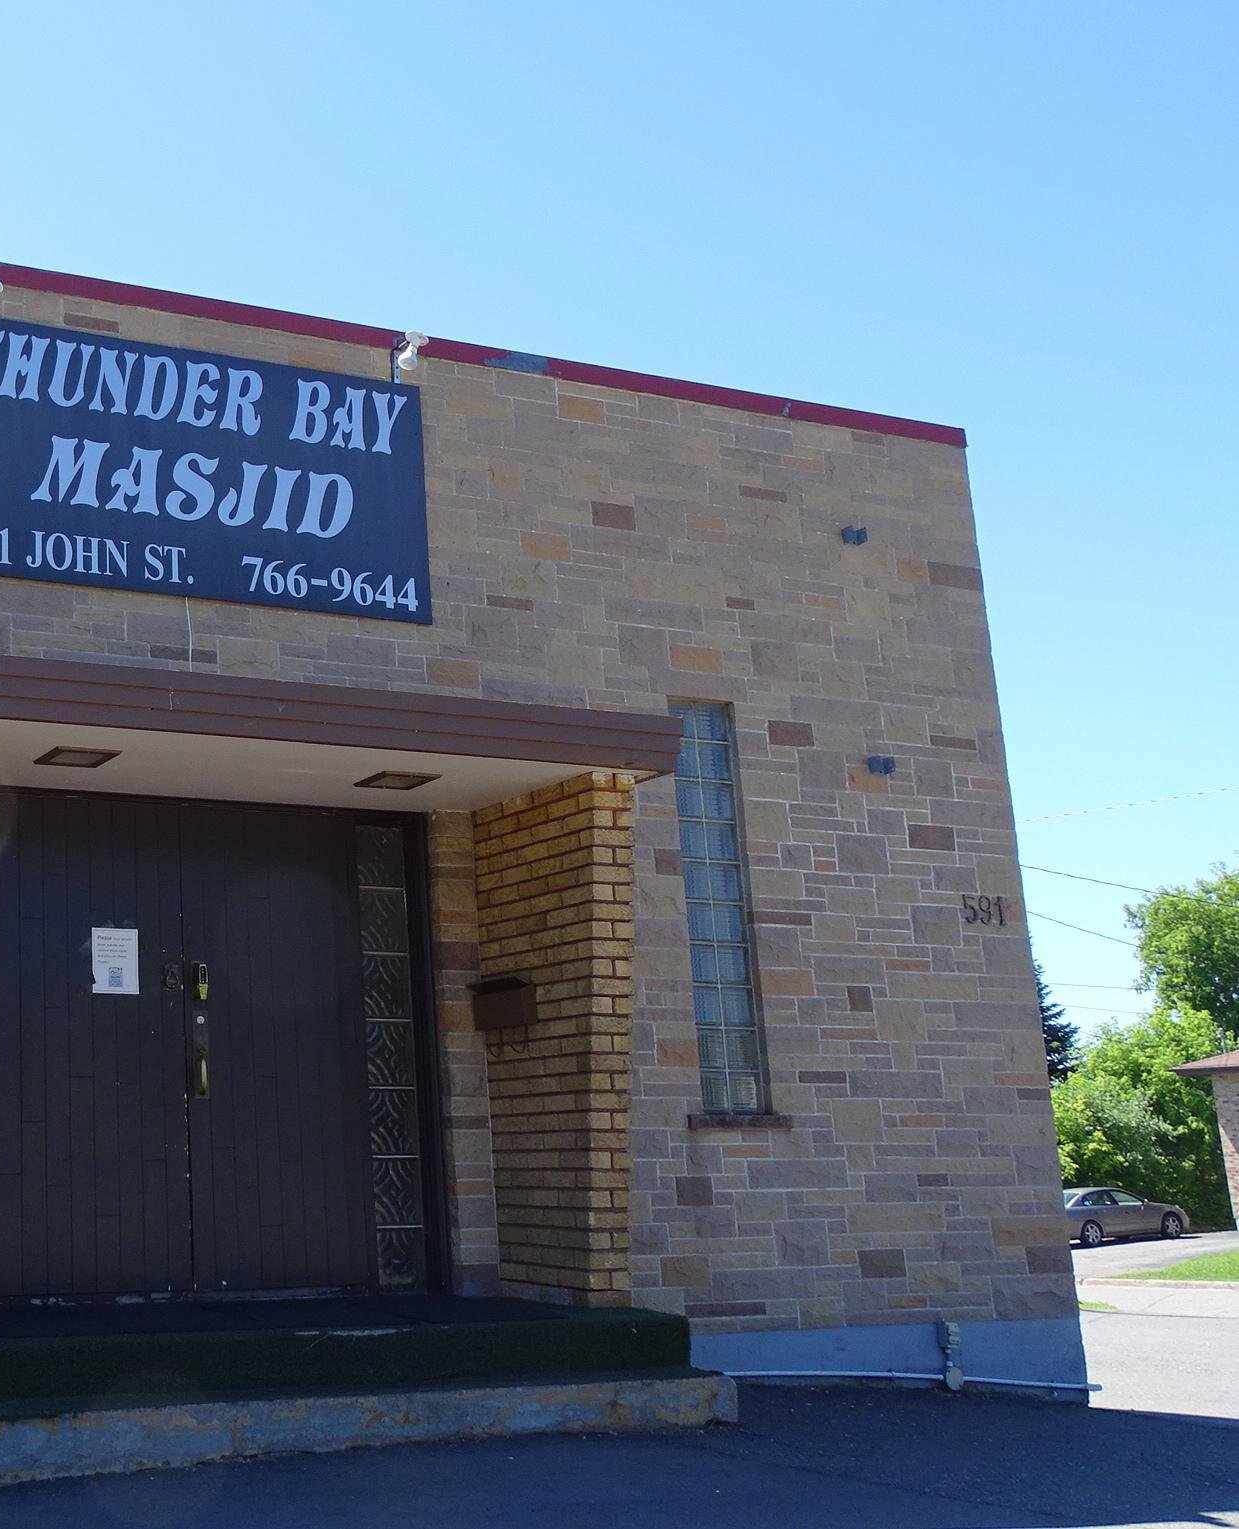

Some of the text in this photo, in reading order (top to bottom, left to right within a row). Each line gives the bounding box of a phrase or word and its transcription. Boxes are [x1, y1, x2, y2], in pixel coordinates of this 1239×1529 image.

[288, 377, 408, 456] BAY
[30, 434, 355, 539] MASJID
[25, 529, 131, 578] JOHN
[143, 542, 195, 586] ST.
[240, 555, 419, 613] 766-9644
[961, 893, 1006, 927] 591
